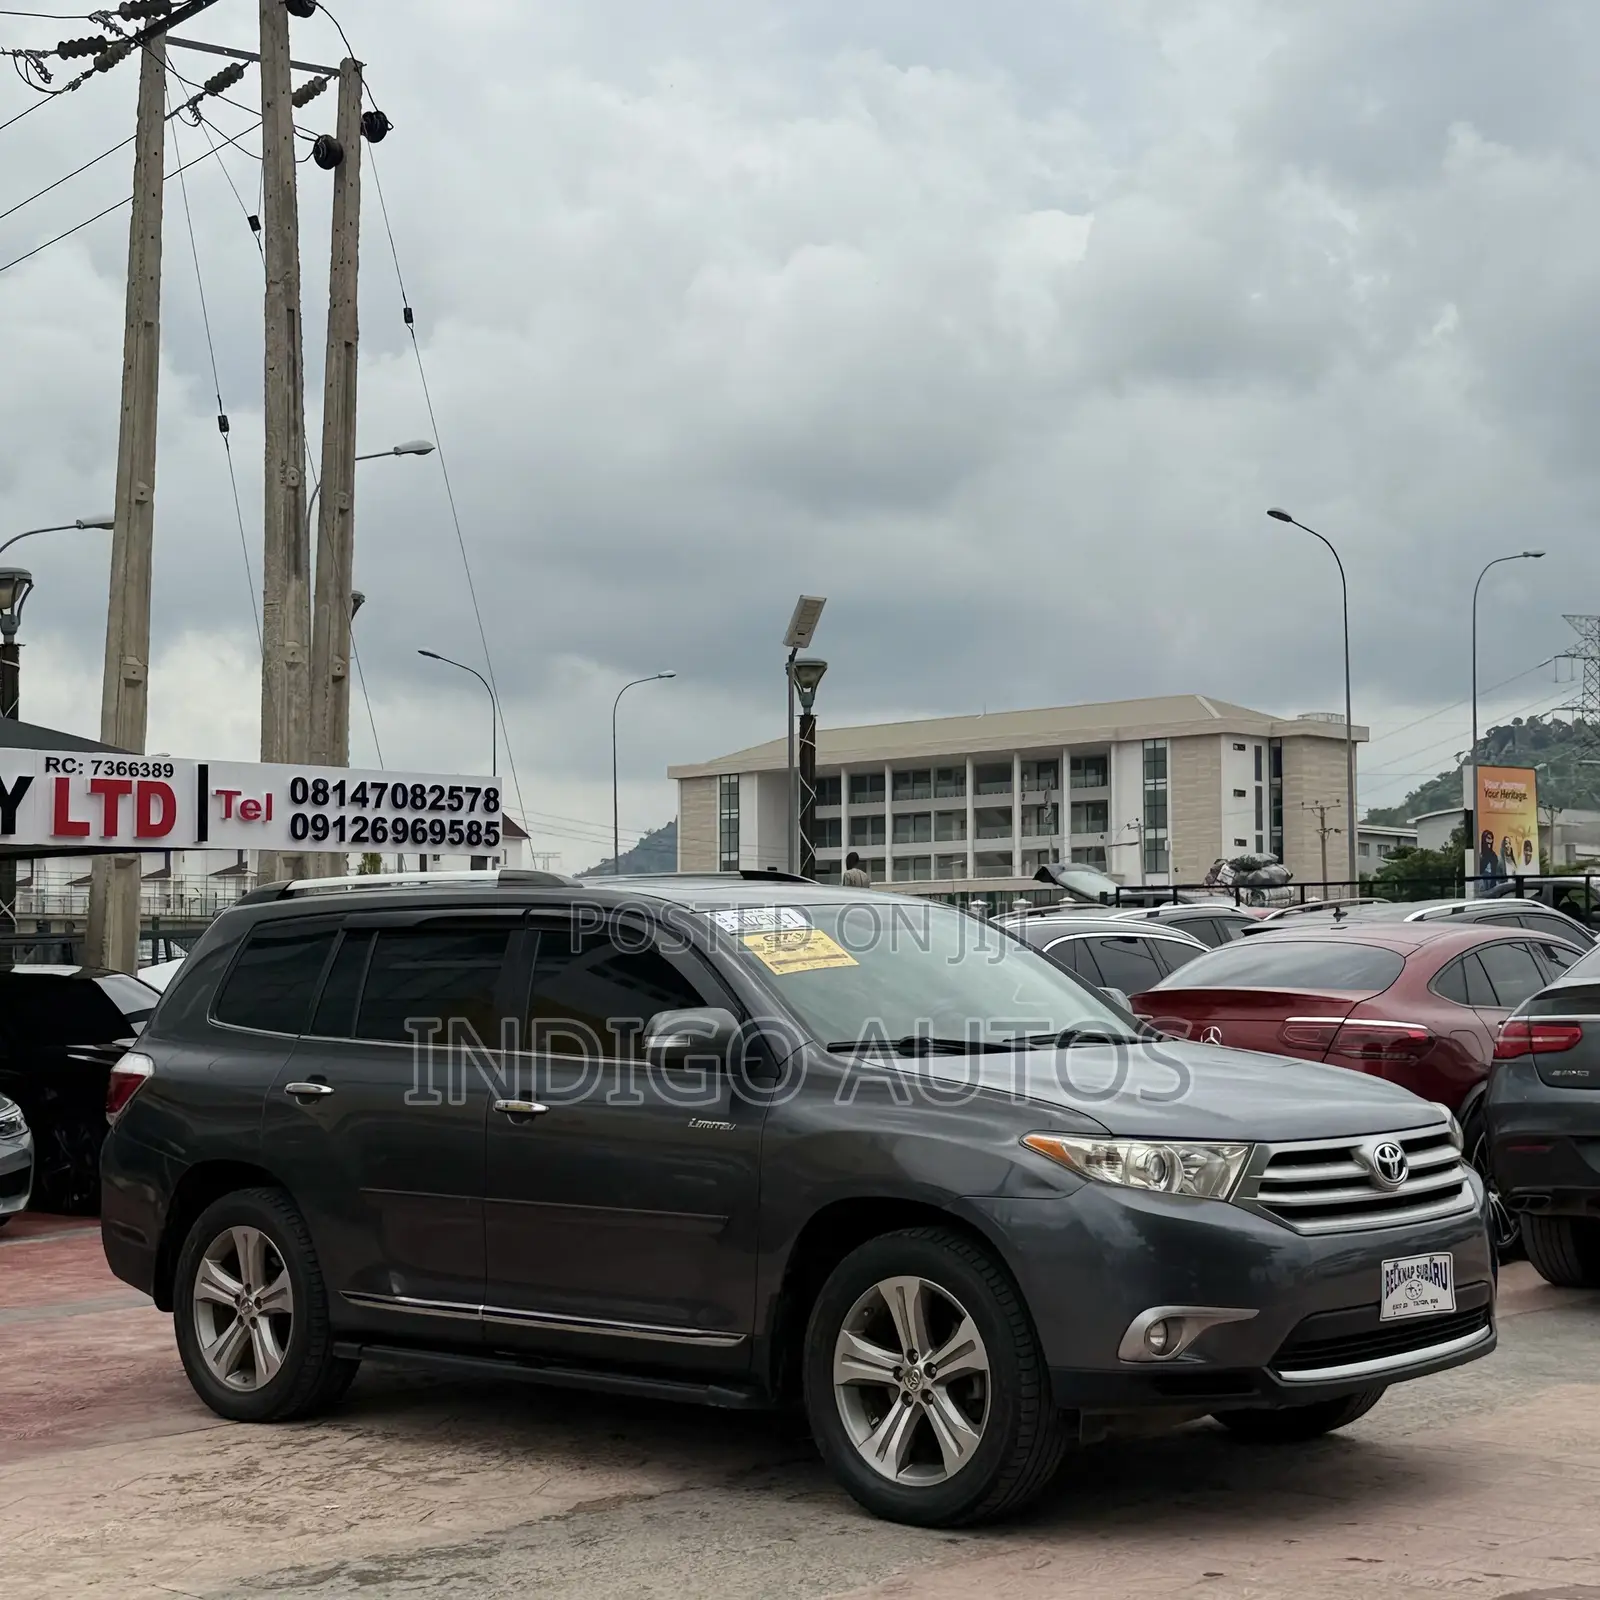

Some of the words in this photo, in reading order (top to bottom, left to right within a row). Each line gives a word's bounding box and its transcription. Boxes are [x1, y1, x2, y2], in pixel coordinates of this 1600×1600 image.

[45, 757, 84, 774] RC:
[91, 760, 174, 778] 7366389
[52, 777, 177, 838] LTD
[214, 789, 273, 822] Tel
[290, 777, 500, 813] 08147082578
[1484, 788, 1499, 798] Your
[290, 813, 500, 847] 09126969585
